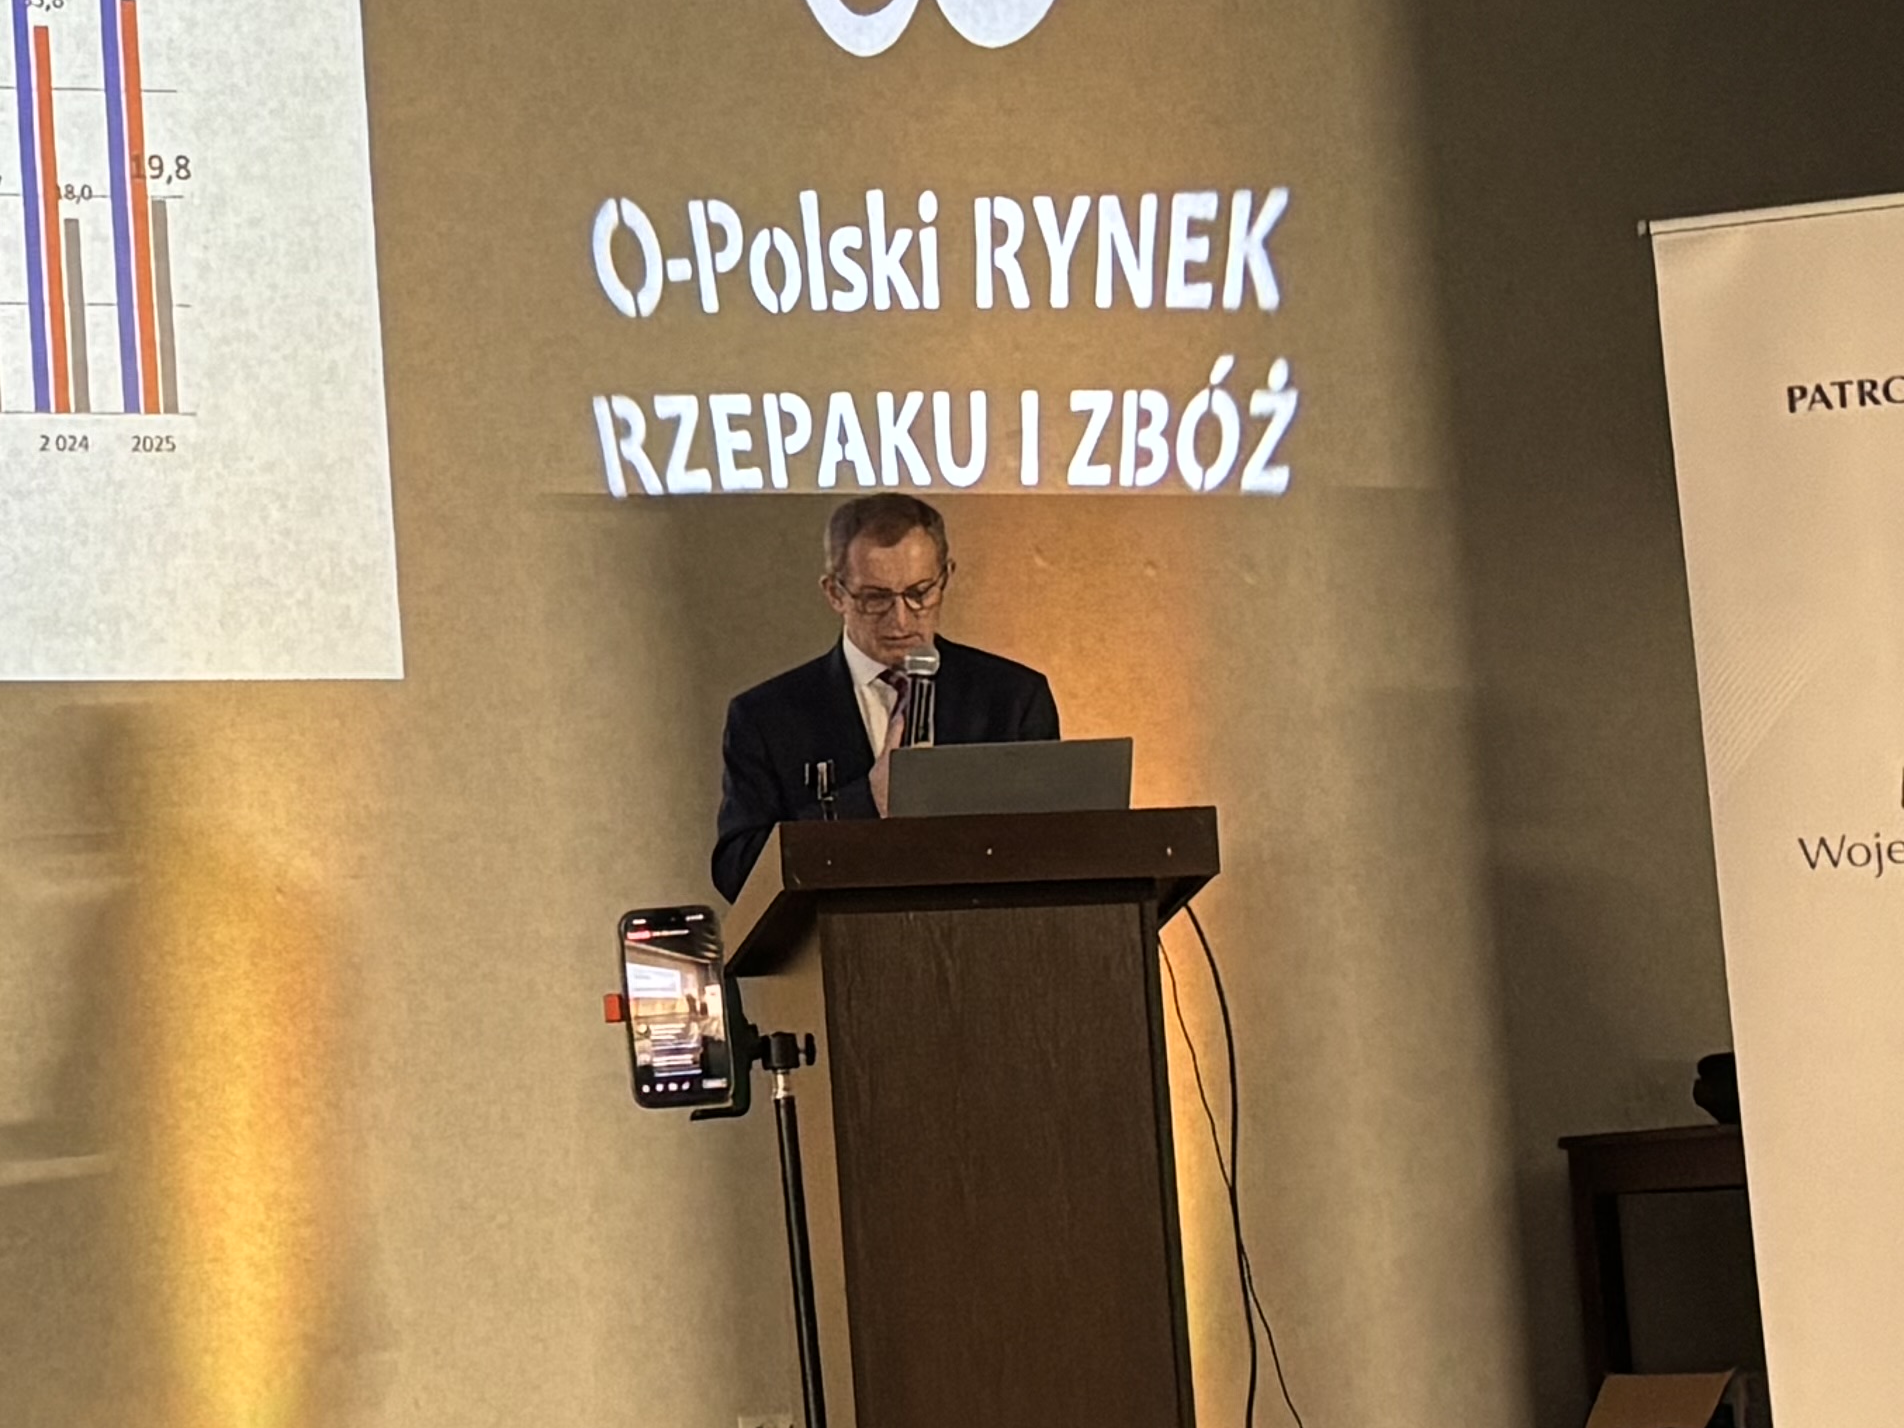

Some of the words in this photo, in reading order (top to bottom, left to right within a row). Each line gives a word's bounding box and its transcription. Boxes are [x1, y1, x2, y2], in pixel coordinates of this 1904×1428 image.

[131, 154, 191, 184] 19,8
[593, 189, 940, 318] O-Polski
[975, 188, 1289, 312] RYNEK
[132, 431, 177, 452] 2025
[593, 390, 987, 499] RZEPAKU
[1021, 390, 1038, 486] I
[1068, 354, 1297, 494] ZBÓŻ
